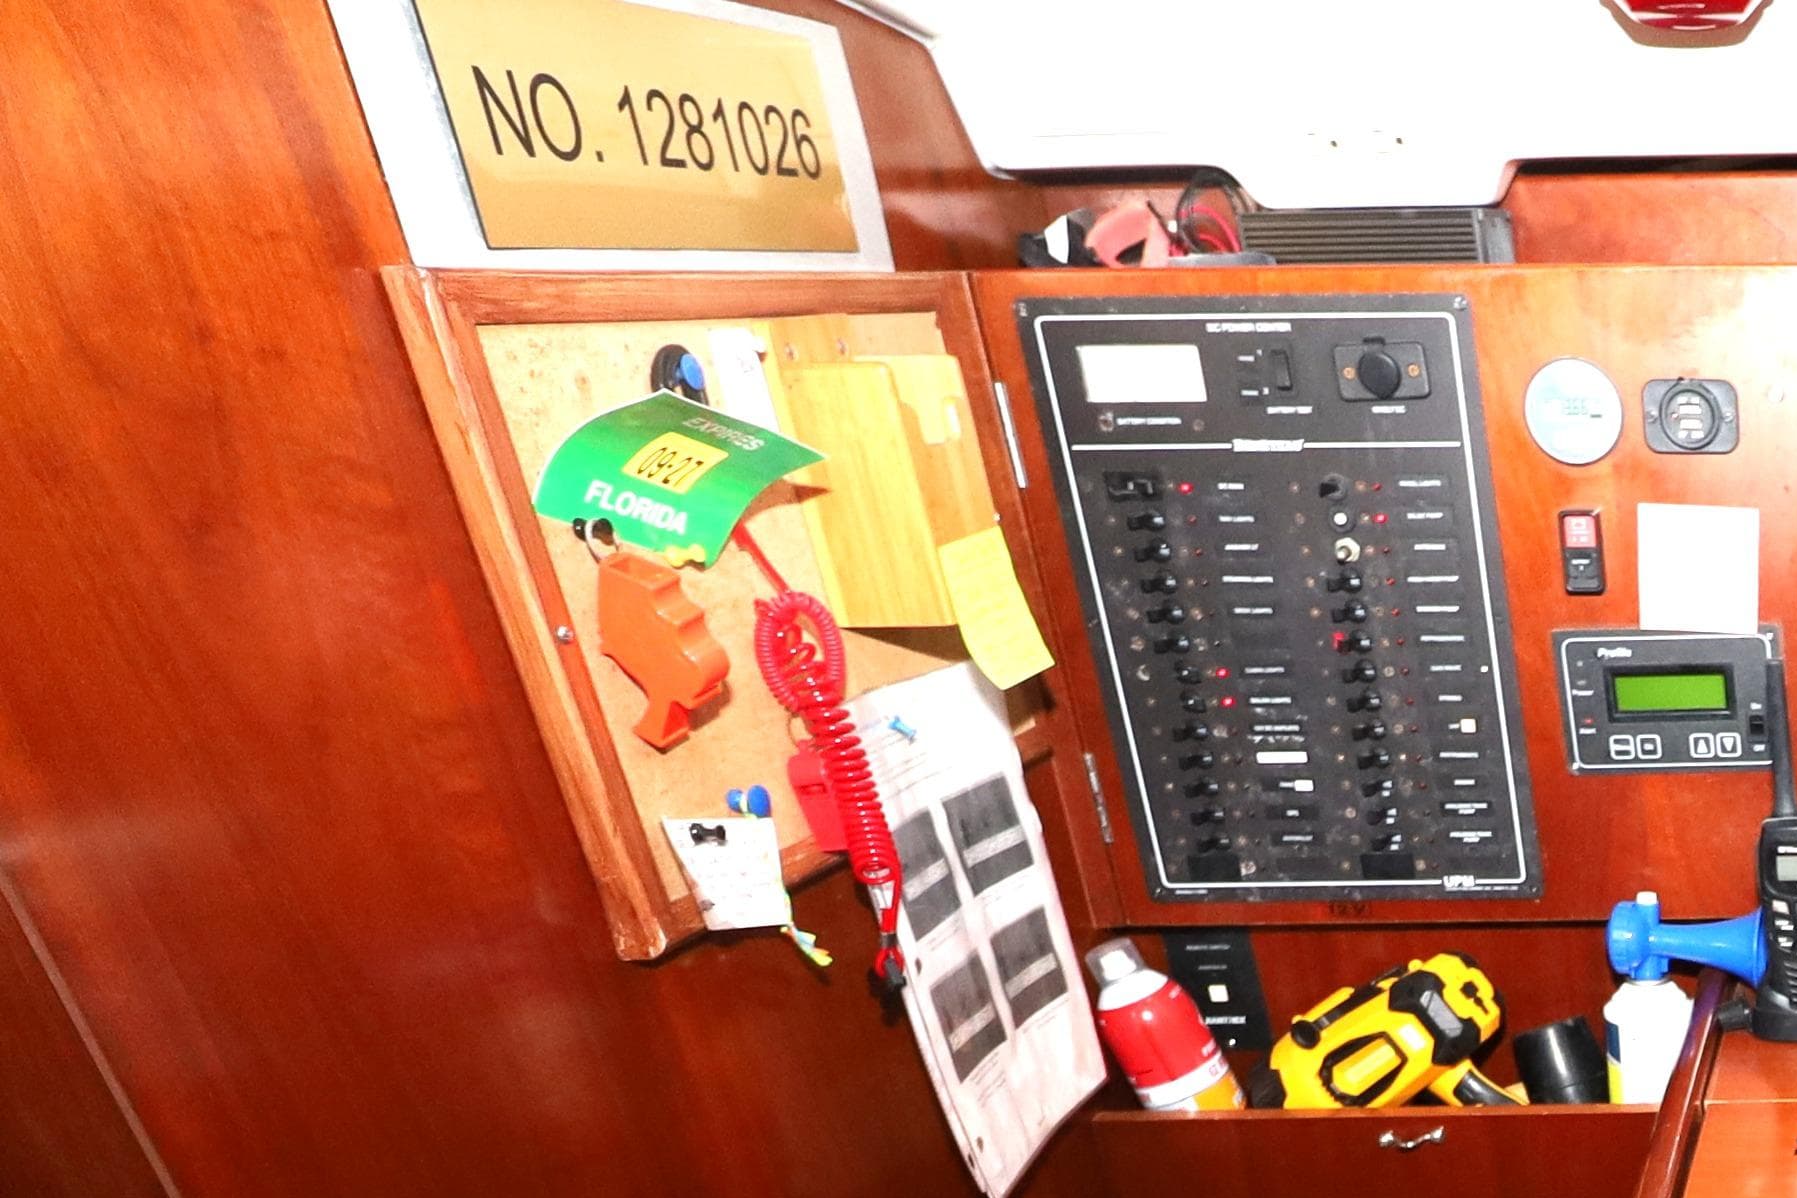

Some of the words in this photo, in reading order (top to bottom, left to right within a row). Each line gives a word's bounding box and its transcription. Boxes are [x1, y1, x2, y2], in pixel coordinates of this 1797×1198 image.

[471, 64, 604, 163] NO.
[618, 85, 822, 179] 1281026
[682, 416, 766, 452] EXPIRES
[584, 479, 689, 536] FLORIDA
